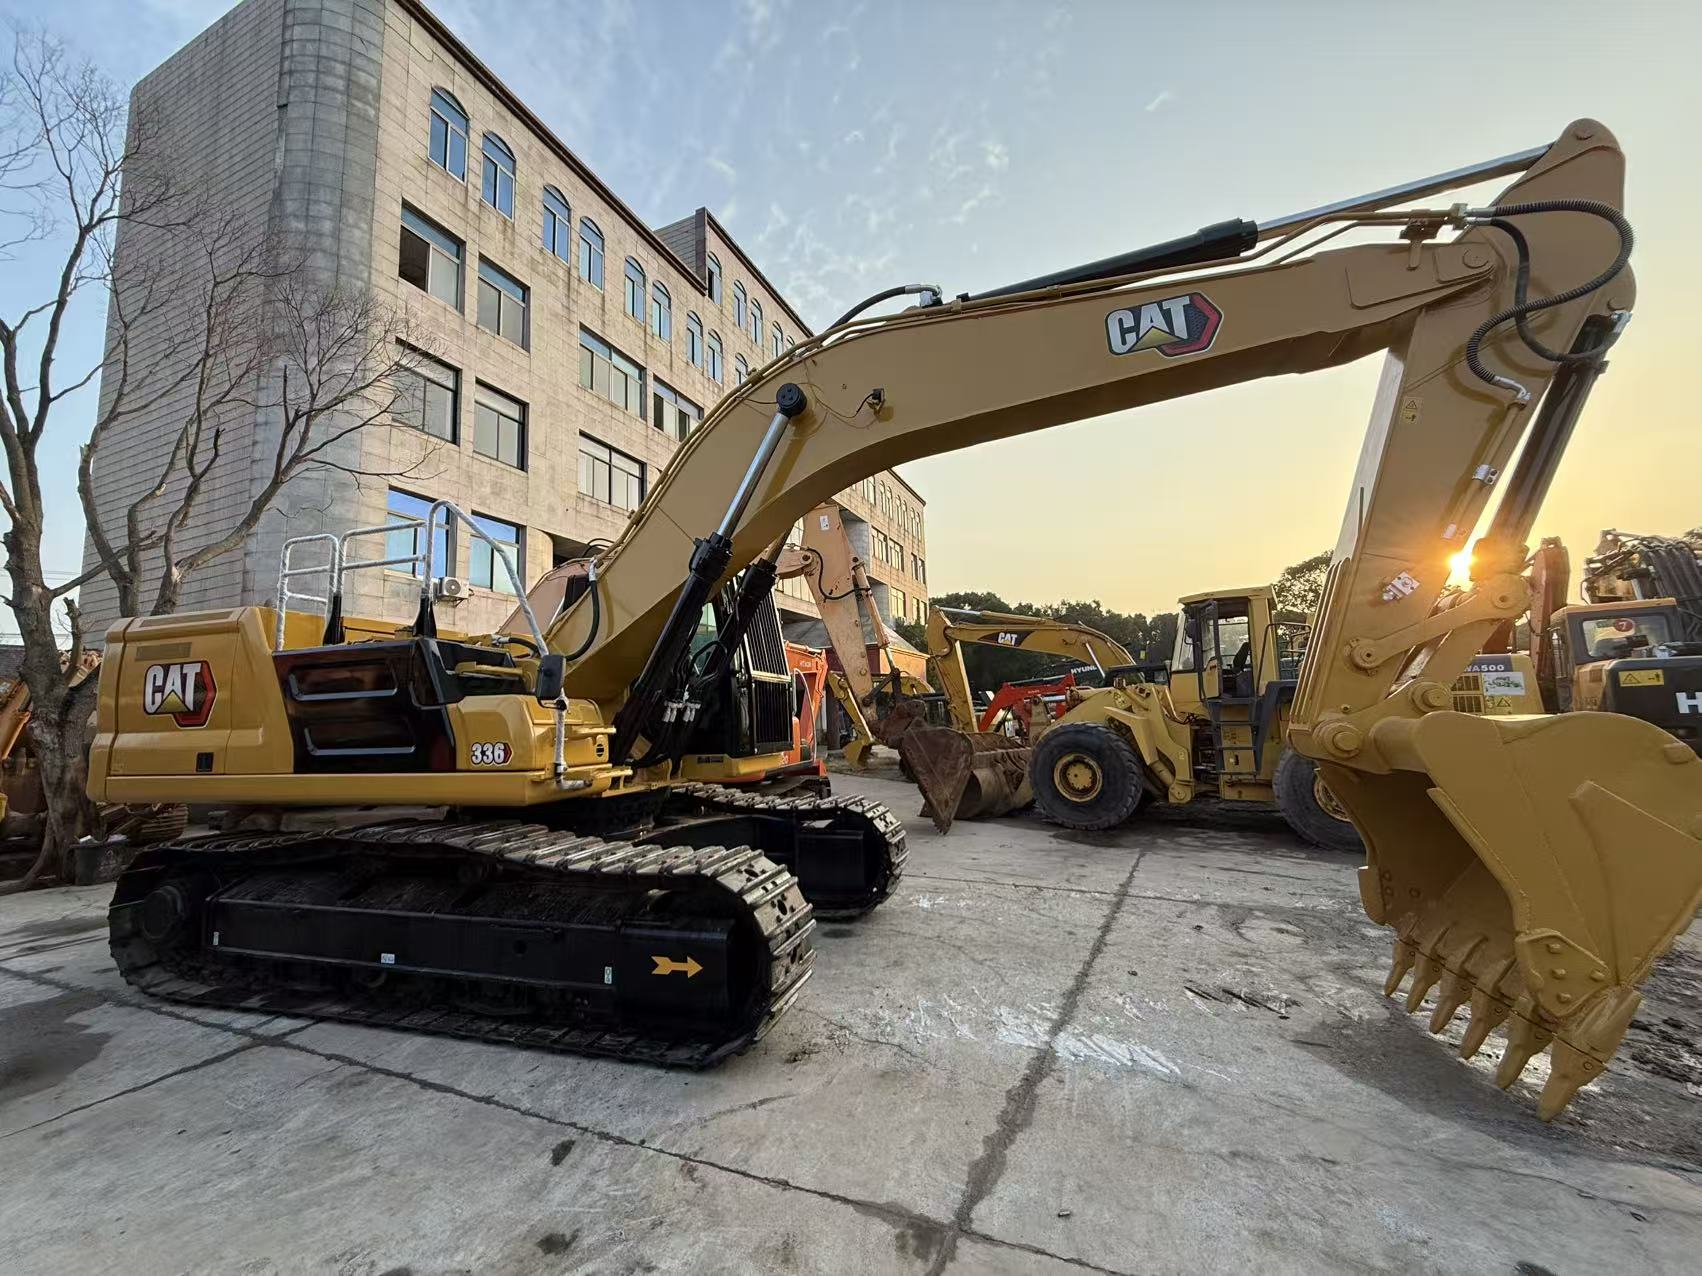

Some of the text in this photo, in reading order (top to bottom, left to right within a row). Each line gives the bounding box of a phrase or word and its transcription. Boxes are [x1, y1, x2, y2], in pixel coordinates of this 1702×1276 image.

[1108, 296, 1190, 353] CAT
[998, 632, 1017, 646] CAT
[145, 663, 202, 714] CAT
[472, 743, 505, 764] 336
